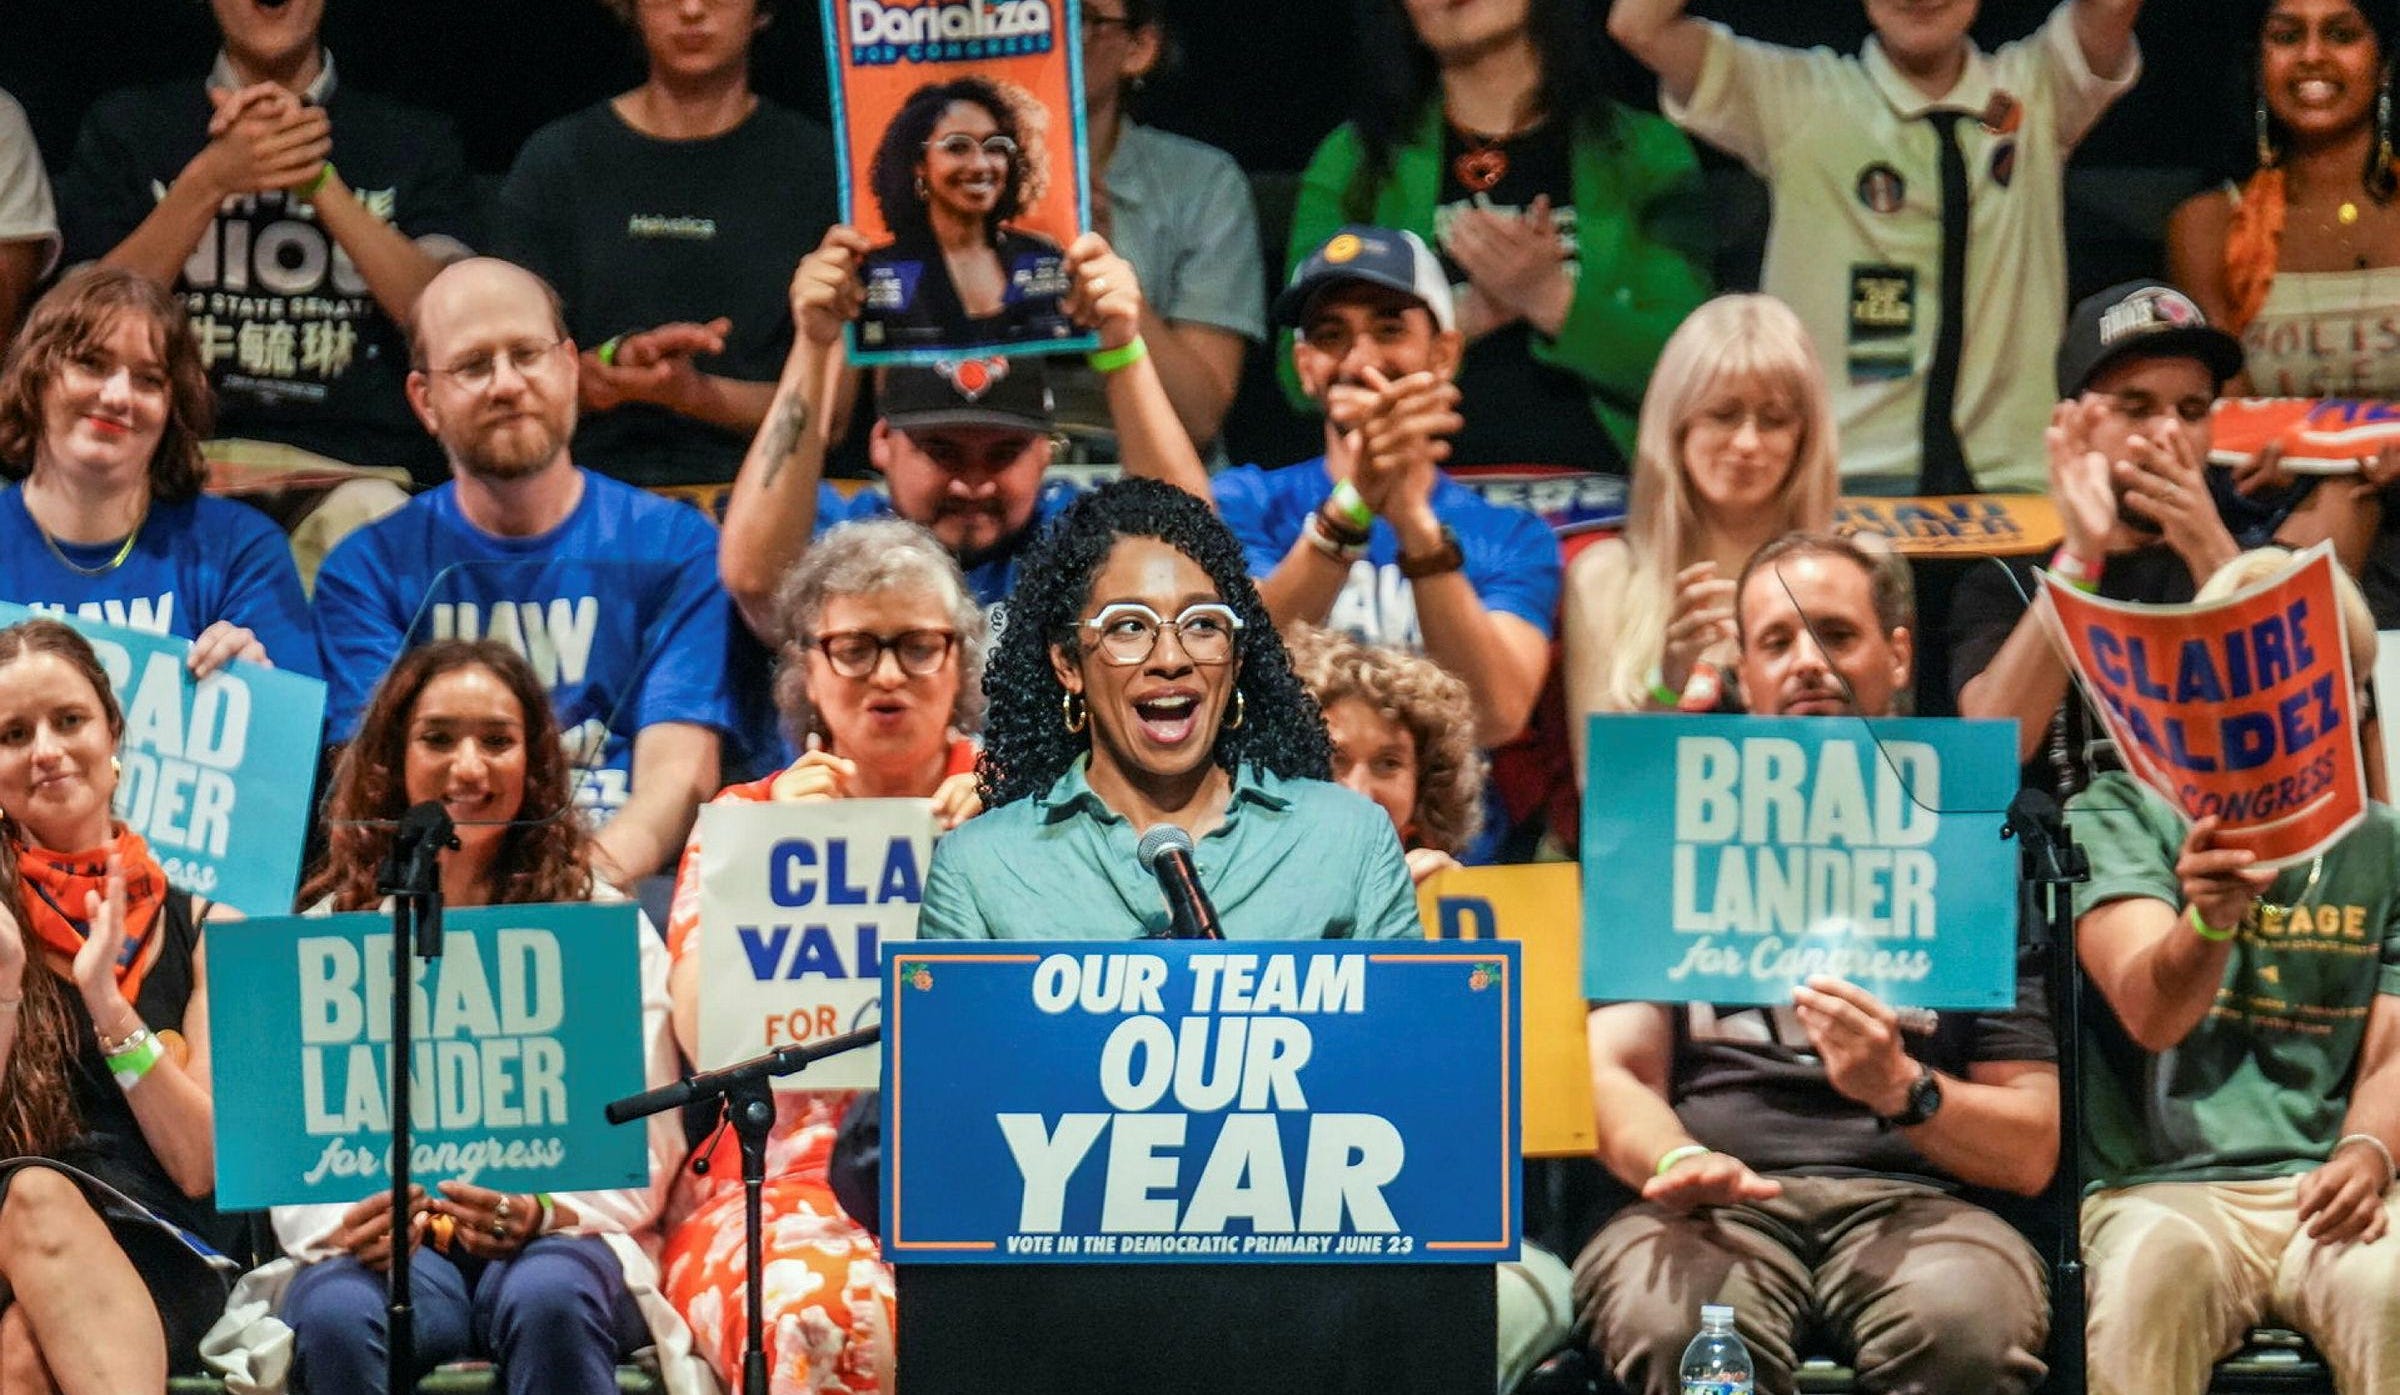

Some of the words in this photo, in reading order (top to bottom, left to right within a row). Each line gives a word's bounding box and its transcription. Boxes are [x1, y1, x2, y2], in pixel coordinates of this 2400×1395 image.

[2088, 596, 2314, 703] CLAIRE
[111, 750, 237, 858] DER
[1674, 735, 1940, 847] BRAD
[769, 837, 923, 908] CLA
[1672, 843, 1937, 939] LANDER
[297, 928, 565, 1043] BRAD
[736, 922, 881, 981] VAL
[1032, 953, 1168, 1014] OUR
[1188, 954, 1366, 1014] TEAM
[1667, 935, 1745, 981] for
[764, 1003, 837, 1047] FOR
[1100, 1015, 1313, 1112] OUR
[302, 1036, 568, 1136] LANDER
[303, 1136, 378, 1185] for
[996, 1113, 1406, 1234] YEAR
[1007, 1235, 1053, 1254] VOTE
[1057, 1235, 1079, 1254] IN
[1083, 1235, 1116, 1254] THE
[1120, 1235, 1240, 1254] DEMOCRATIC
[1242, 1235, 1333, 1254] PRIMARY
[1334, 1235, 1383, 1254] JUNE
[1386, 1235, 1414, 1254] 23
